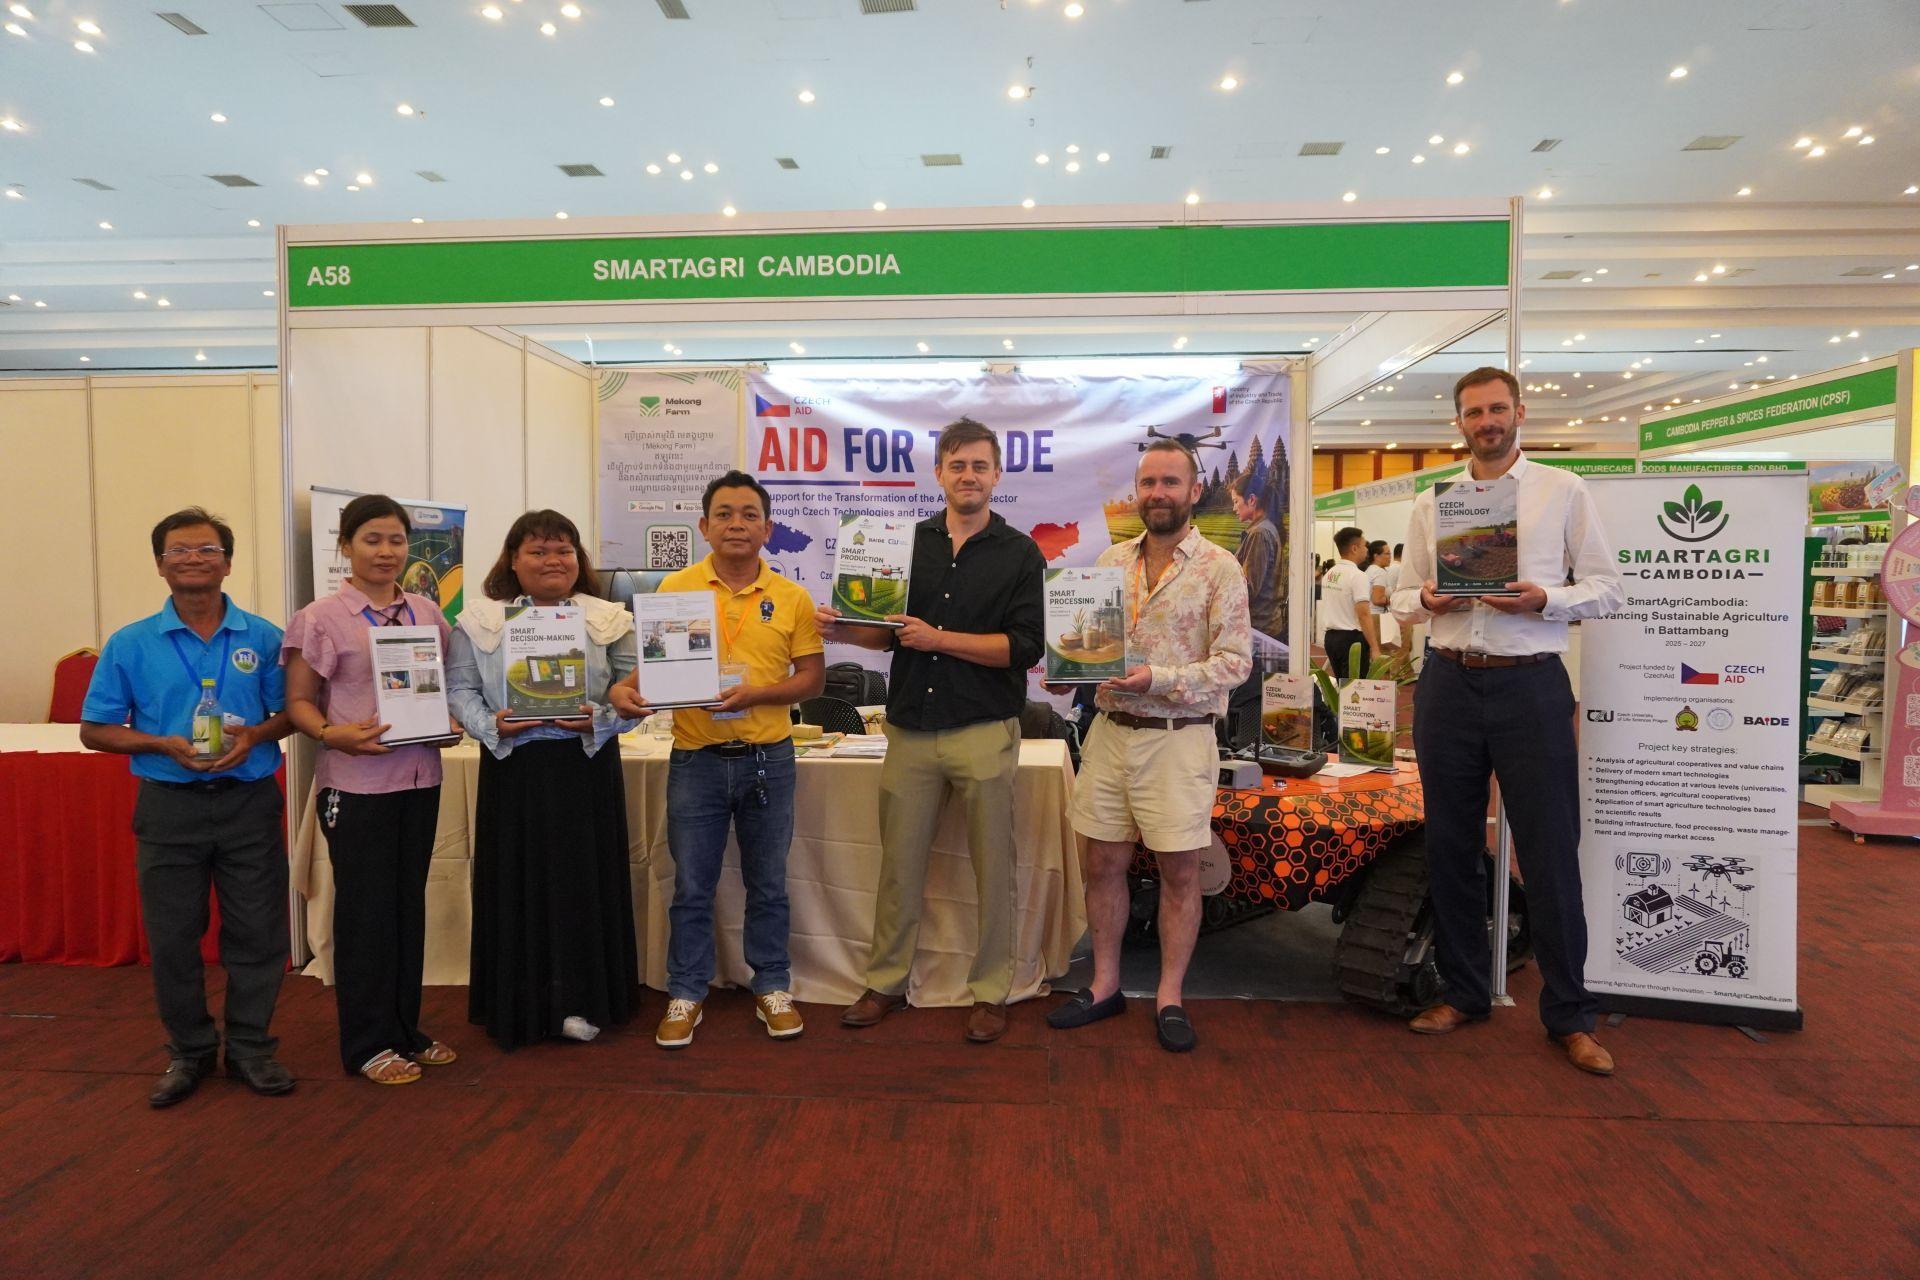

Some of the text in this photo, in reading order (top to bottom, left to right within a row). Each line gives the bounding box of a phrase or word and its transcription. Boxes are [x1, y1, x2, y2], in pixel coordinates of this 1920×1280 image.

[593, 253, 901, 281] SMARTAGRI CAMBODIA
[307, 265, 351, 287] A58
[666, 398, 702, 406] Mekong
[794, 396, 830, 406] CZECH
[666, 408, 690, 416] Farm
[794, 406, 812, 415] AID
[1666, 422, 1700, 438] CAMBODIA
[1701, 416, 1728, 432] PEPPER
[1730, 414, 1736, 426] &
[1736, 409, 1764, 424] SPICES
[1766, 398, 1818, 418] FEDERATION
[1820, 390, 1850, 409] (CPSF)
[758, 426, 1054, 473] AID FOR TDE
[1574, 465, 1633, 473] NATURECARE
[802, 492, 815, 501] for
[818, 493, 832, 501] the
[835, 493, 906, 502] Transformation
[908, 494, 917, 502] of
[920, 494, 935, 502] the
[802, 506, 830, 516] Czech
[898, 508, 915, 517] and
[1440, 508, 1490, 516] TECHNOLOGY
[840, 554, 884, 563] PRODUCTION
[1618, 549, 1770, 564] SMARTAGRI
[794, 566, 806, 580] 1.
[1640, 569, 1746, 579] CAMBODIA
[1627, 597, 1748, 607] SmartAgriCambodia:
[1651, 611, 1719, 621] Sustainable
[1723, 613, 1789, 623] Agriculture
[1645, 626, 1729, 637] in Battambang
[510, 634, 576, 642] DECISION-MAKING
[1724, 665, 1765, 674] CZECH
[1724, 675, 1745, 684] AID
[1266, 692, 1296, 700] TECHNOLOGY
[1643, 695, 1735, 704] Implementing organisations:
[1638, 742, 1738, 755] Project key strategies:
[1596, 757, 1625, 765] Analysis
[1636, 759, 1675, 767] agricultural
[1676, 761, 1722, 769] cooperatives
[1596, 767, 1623, 776] Delivery
[1683, 772, 1730, 780] technologies
[1596, 778, 1644, 786] Strengthening
[1645, 780, 1679, 788] education
[1630, 789, 1658, 797] officers,
[1660, 790, 1700, 799] agricultural
[1702, 792, 1750, 802] cooperatives)
[1595, 798, 1634, 807] Application
[1666, 802, 1704, 811] agriculture
[1705, 803, 1752, 813] technologies
[1754, 806, 1776, 814] based
[1595, 819, 1624, 828] Building
[1625, 820, 1674, 829] infrastructure,
[1693, 824, 1735, 834] processing,
[1737, 826, 1758, 834] waste
[1760, 828, 1790, 836] manage-
[1628, 830, 1663, 840] improving
[1690, 834, 1715, 842] access
[1613, 981, 1646, 990] Agriculture
[1647, 984, 1671, 992] through
[1714, 990, 1793, 1004] SmartAgriCambodia.com
